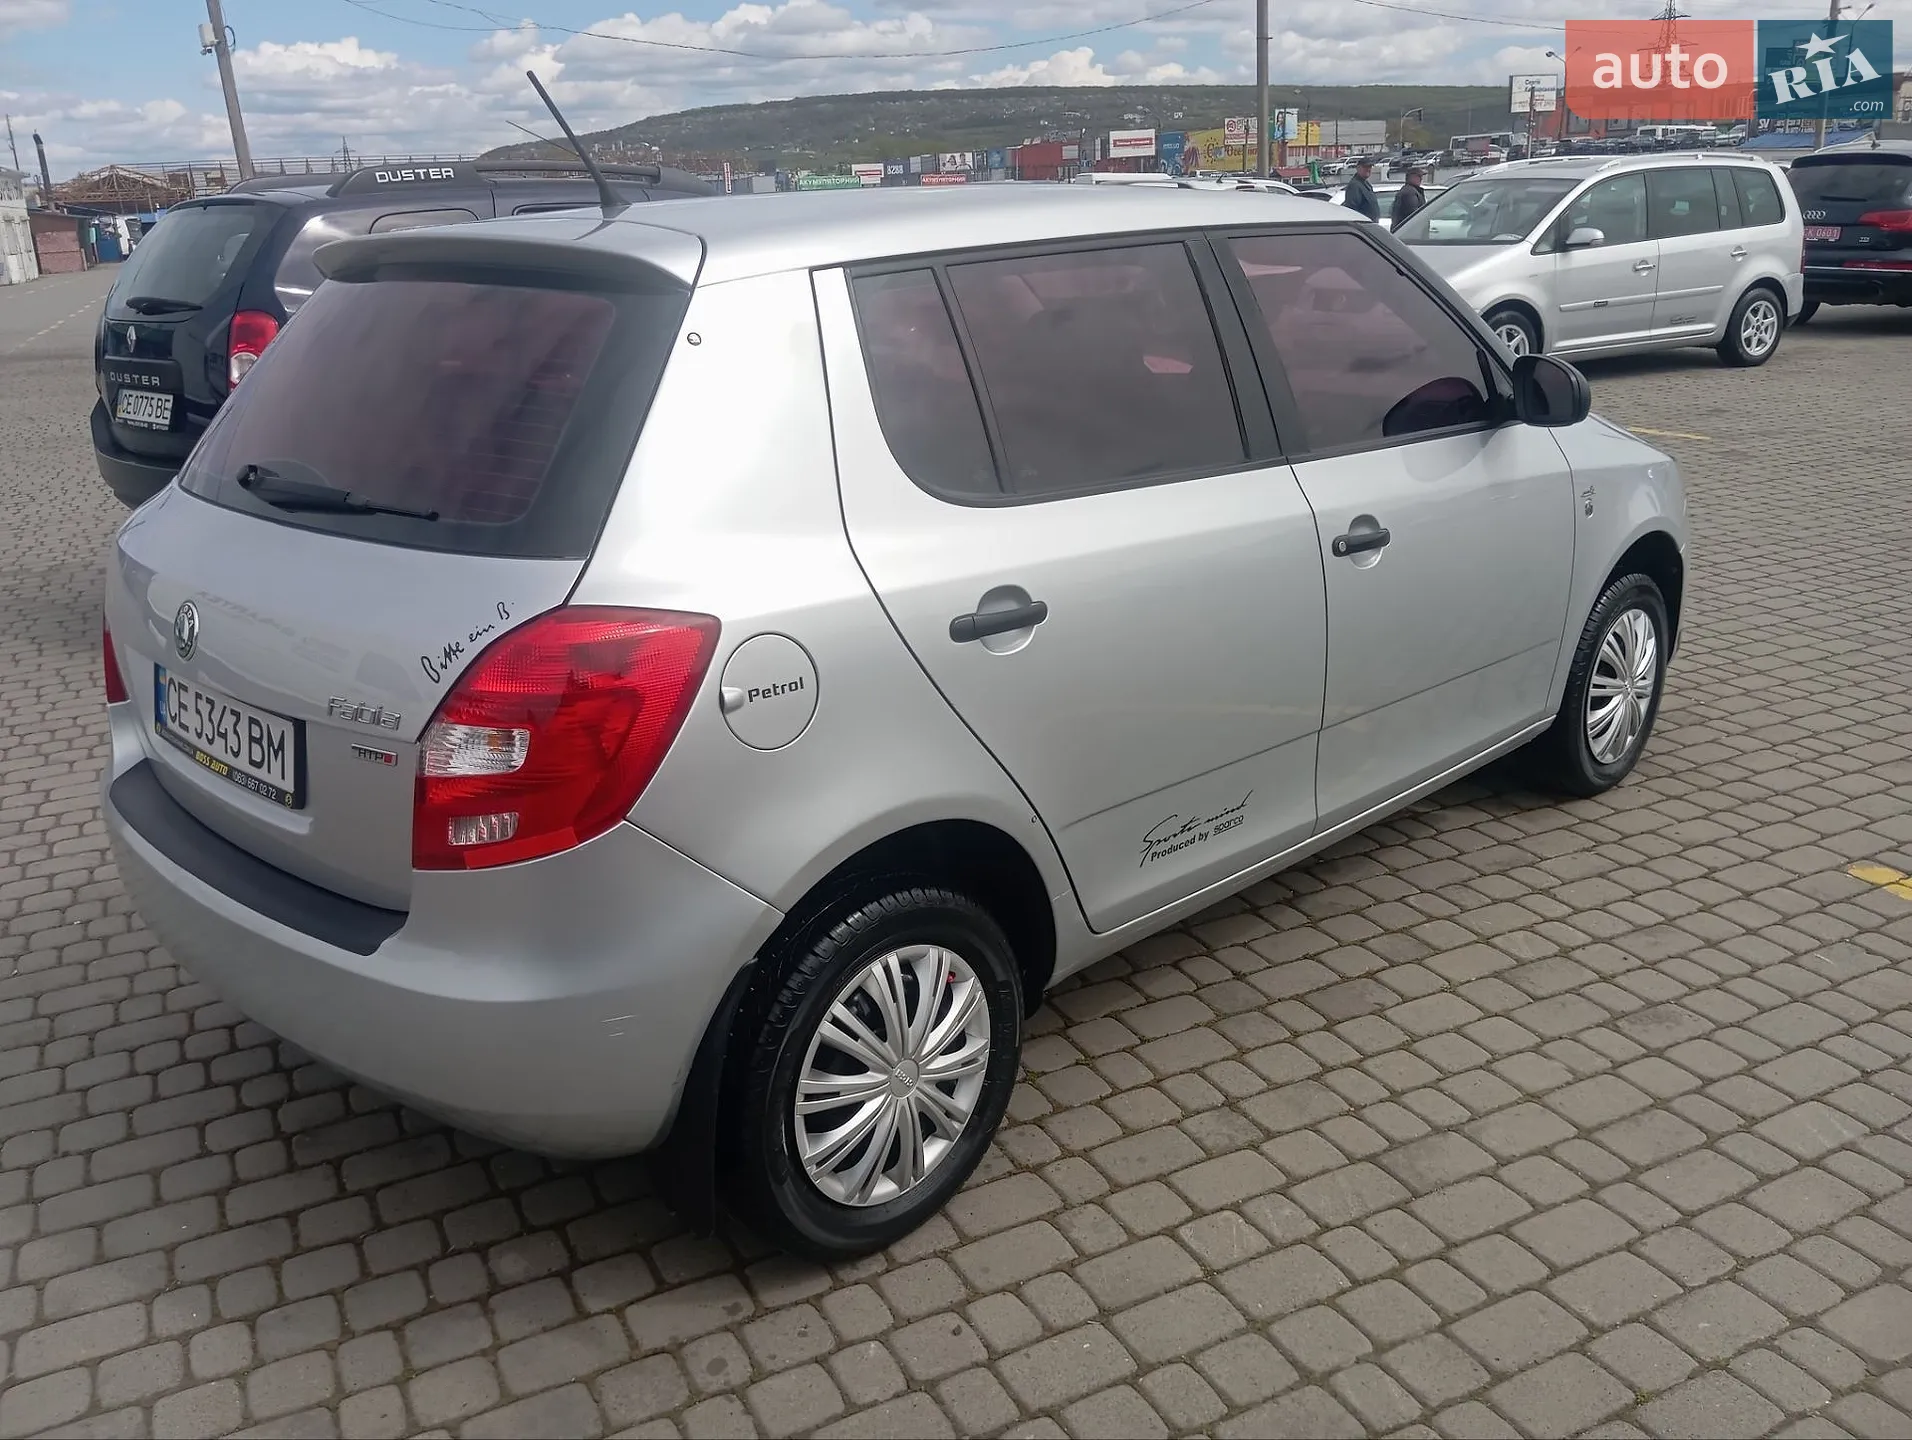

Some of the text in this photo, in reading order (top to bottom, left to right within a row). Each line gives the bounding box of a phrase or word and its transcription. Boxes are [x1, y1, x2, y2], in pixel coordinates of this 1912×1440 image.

[375, 168, 454, 183] DUSTER
[110, 372, 160, 386] DUSTER
[122, 394, 171, 420] CE 0775 BE
[421, 641, 464, 683] Bitte
[469, 623, 495, 642] ein
[748, 677, 804, 703] Petrol
[328, 696, 401, 731] Fabia
[167, 677, 285, 782] CE 5343 BM
[195, 750, 229, 776] BOSS AUTO
[268, 786, 277, 800] 72
[1151, 815, 1244, 861] Produced by sparco
